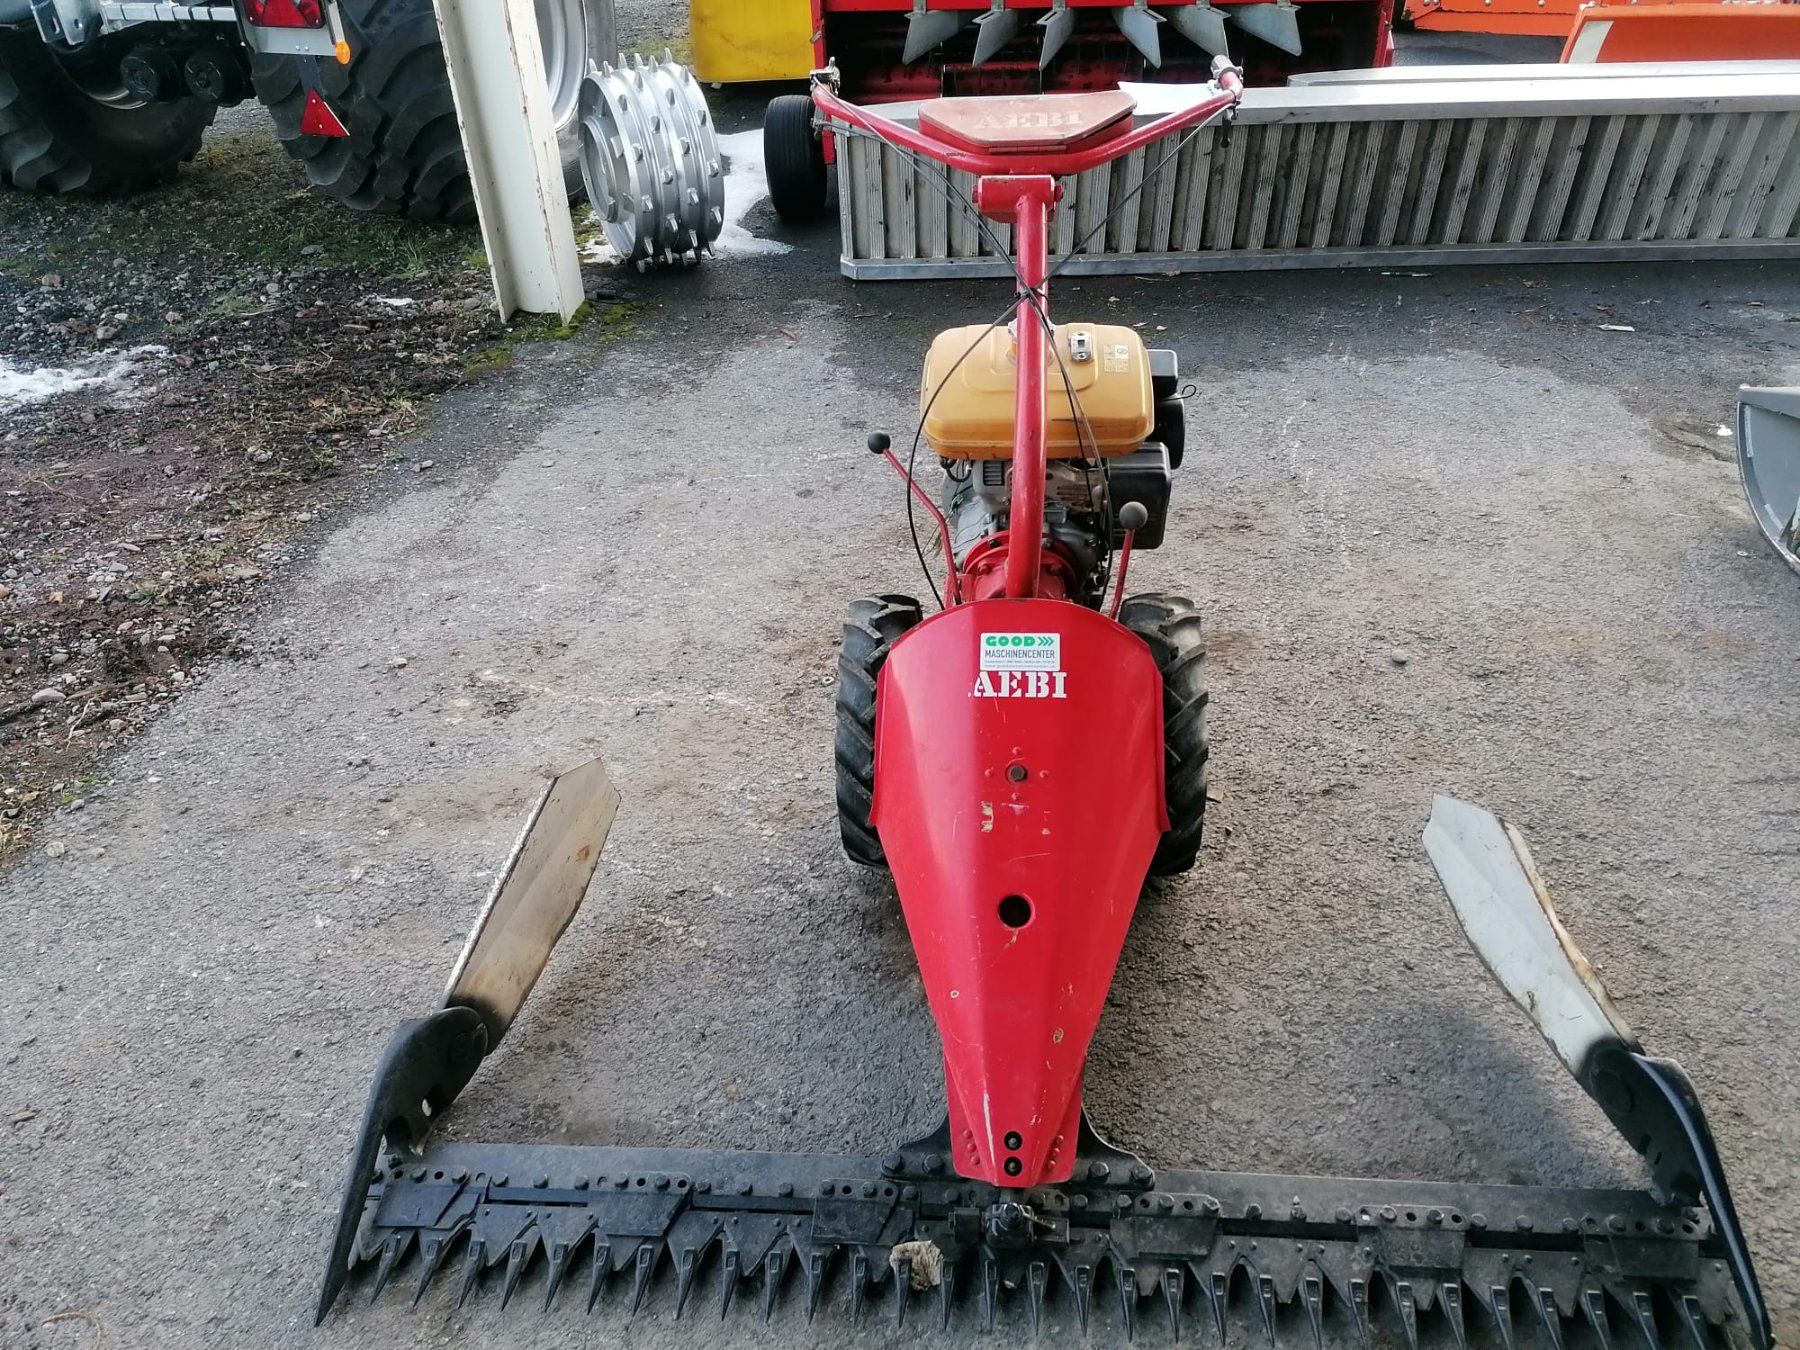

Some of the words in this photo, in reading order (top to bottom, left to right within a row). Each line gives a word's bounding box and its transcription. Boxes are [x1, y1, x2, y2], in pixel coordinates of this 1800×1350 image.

[974, 110, 1082, 129] AEBI
[985, 636, 1036, 647] GOOD
[985, 649, 1055, 659] MASCHINENCENTER
[973, 671, 1068, 699] AEBI
